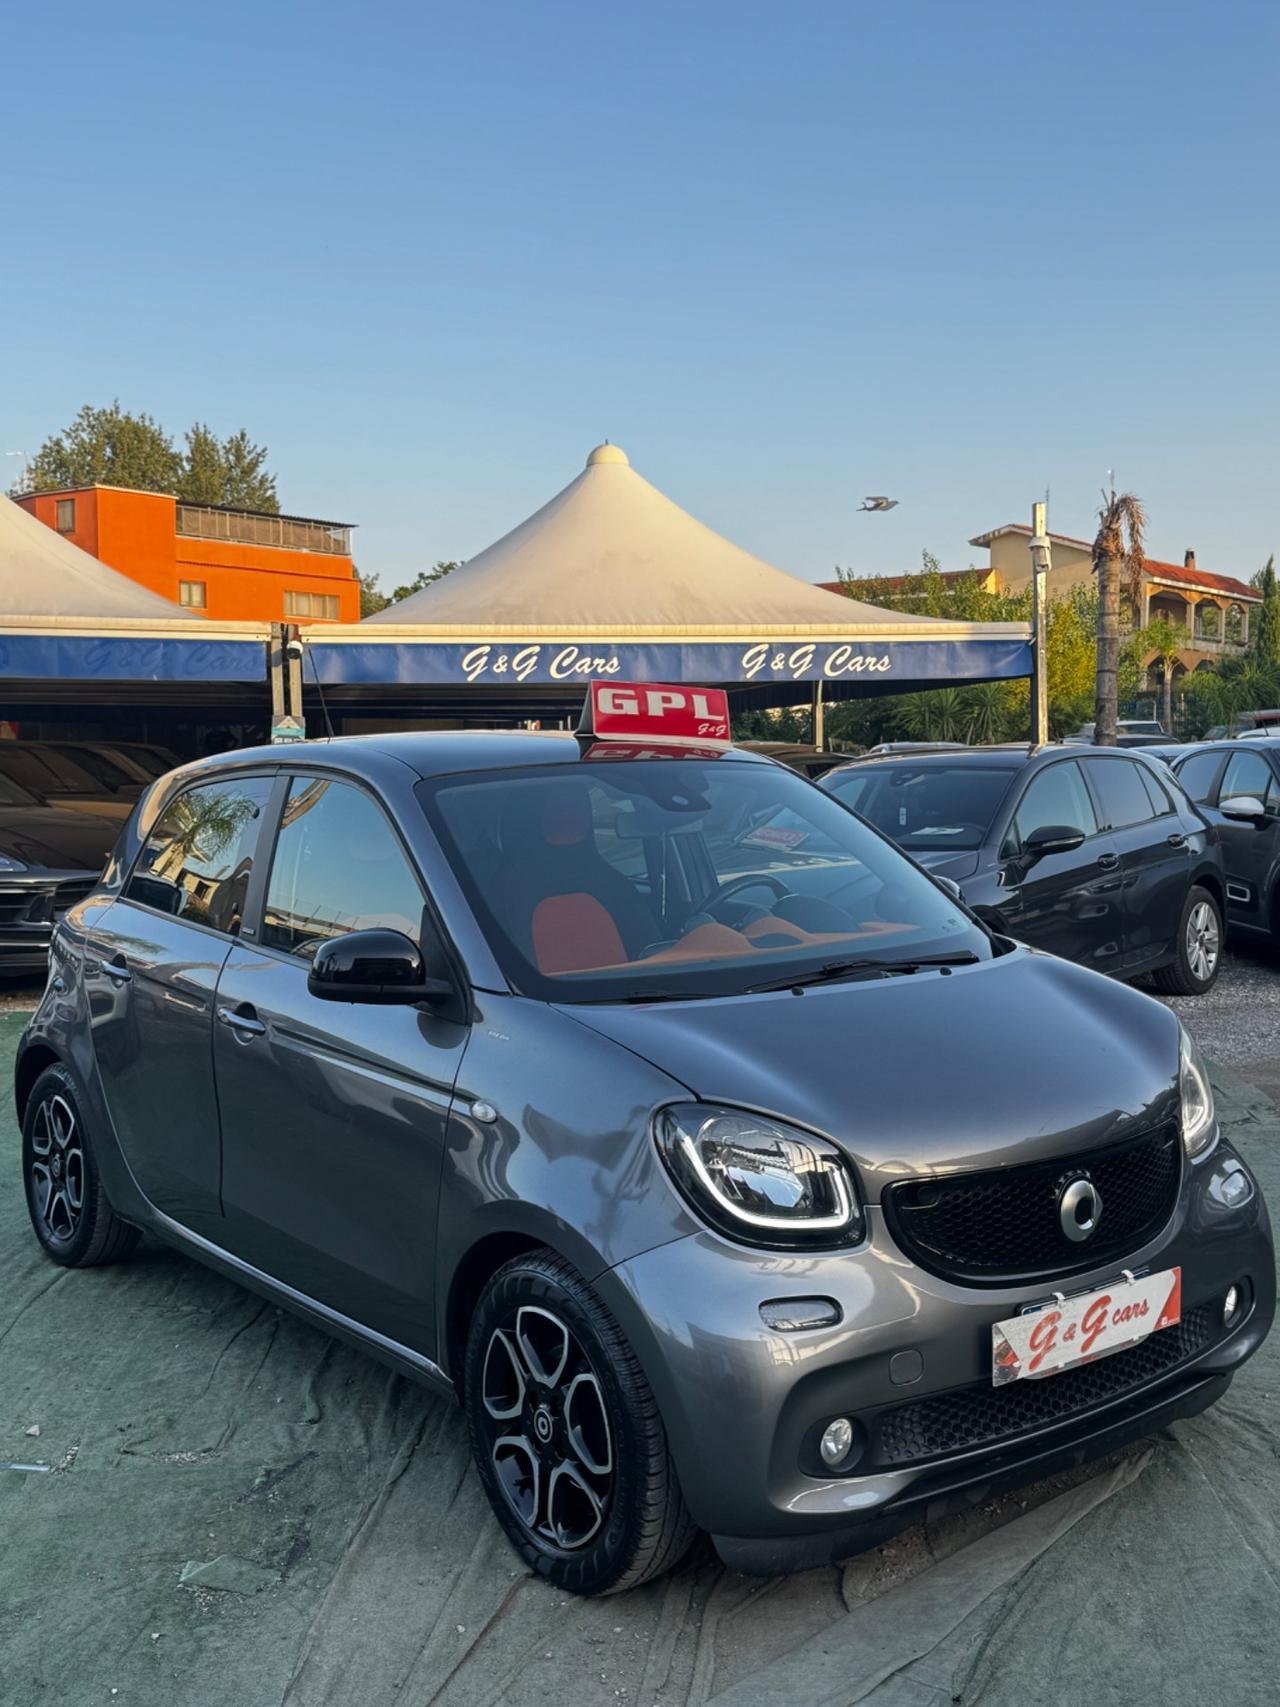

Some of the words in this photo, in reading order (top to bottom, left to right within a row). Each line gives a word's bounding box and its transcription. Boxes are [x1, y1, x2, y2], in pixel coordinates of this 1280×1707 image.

[549, 646, 621, 679] Cars
[823, 645, 892, 677] Cars
[597, 688, 724, 721] GPL
[1112, 1298, 1149, 1325] cars
